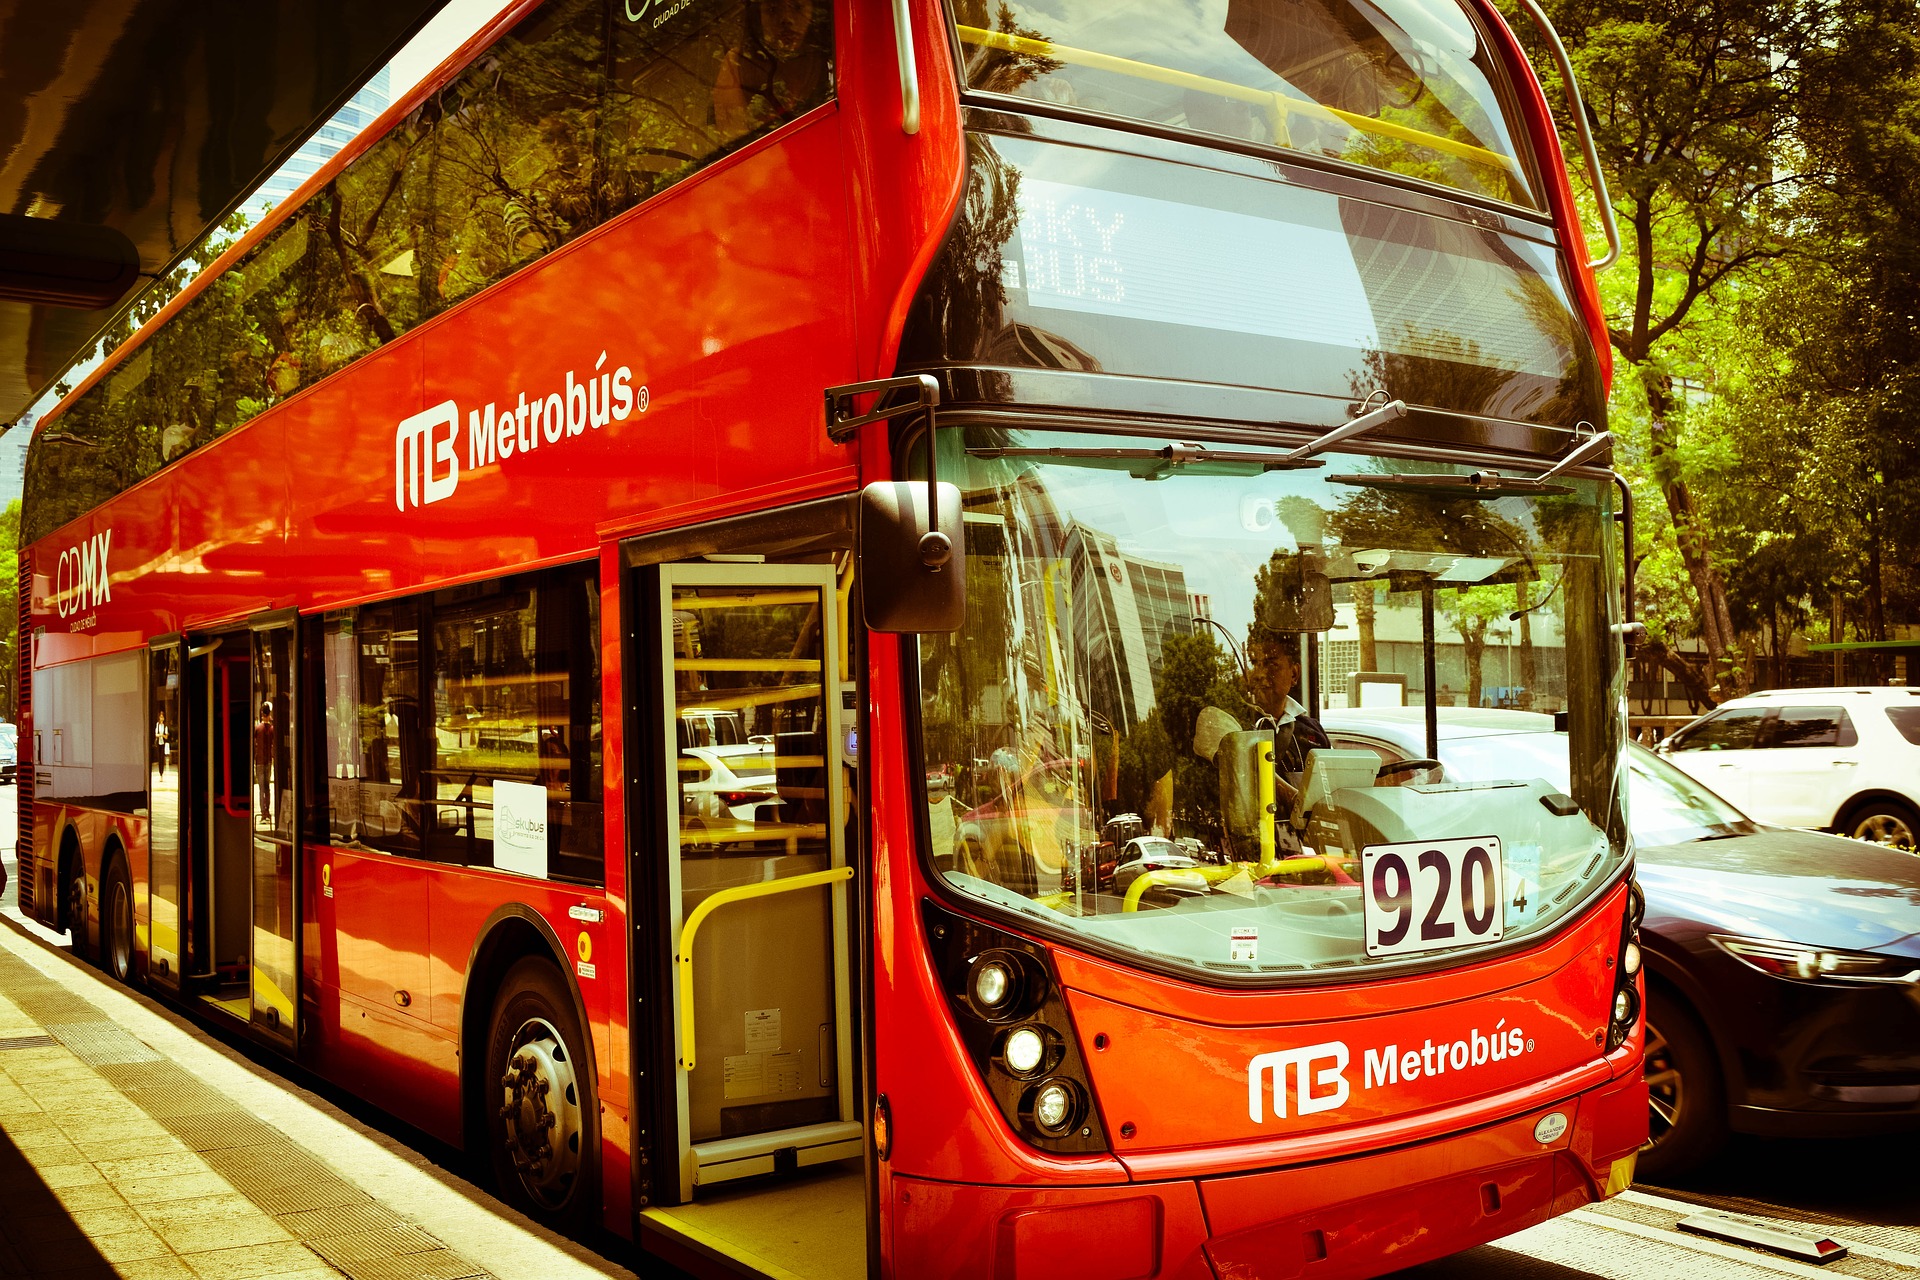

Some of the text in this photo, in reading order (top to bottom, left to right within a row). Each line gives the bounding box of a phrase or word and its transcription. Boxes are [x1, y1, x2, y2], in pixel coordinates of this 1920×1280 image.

[653, 3, 680, 29] CIUDAD
[468, 349, 634, 471] Metrobús
[57, 528, 112, 619] CDMX
[515, 817, 545, 834] skybus
[1372, 846, 1497, 946] 920
[1512, 877, 1528, 913] 4
[1363, 1017, 1525, 1090] Metrobús
[1537, 1124, 1565, 1137] ALEXANDER
[1542, 1131, 1560, 1141] DENNIS
